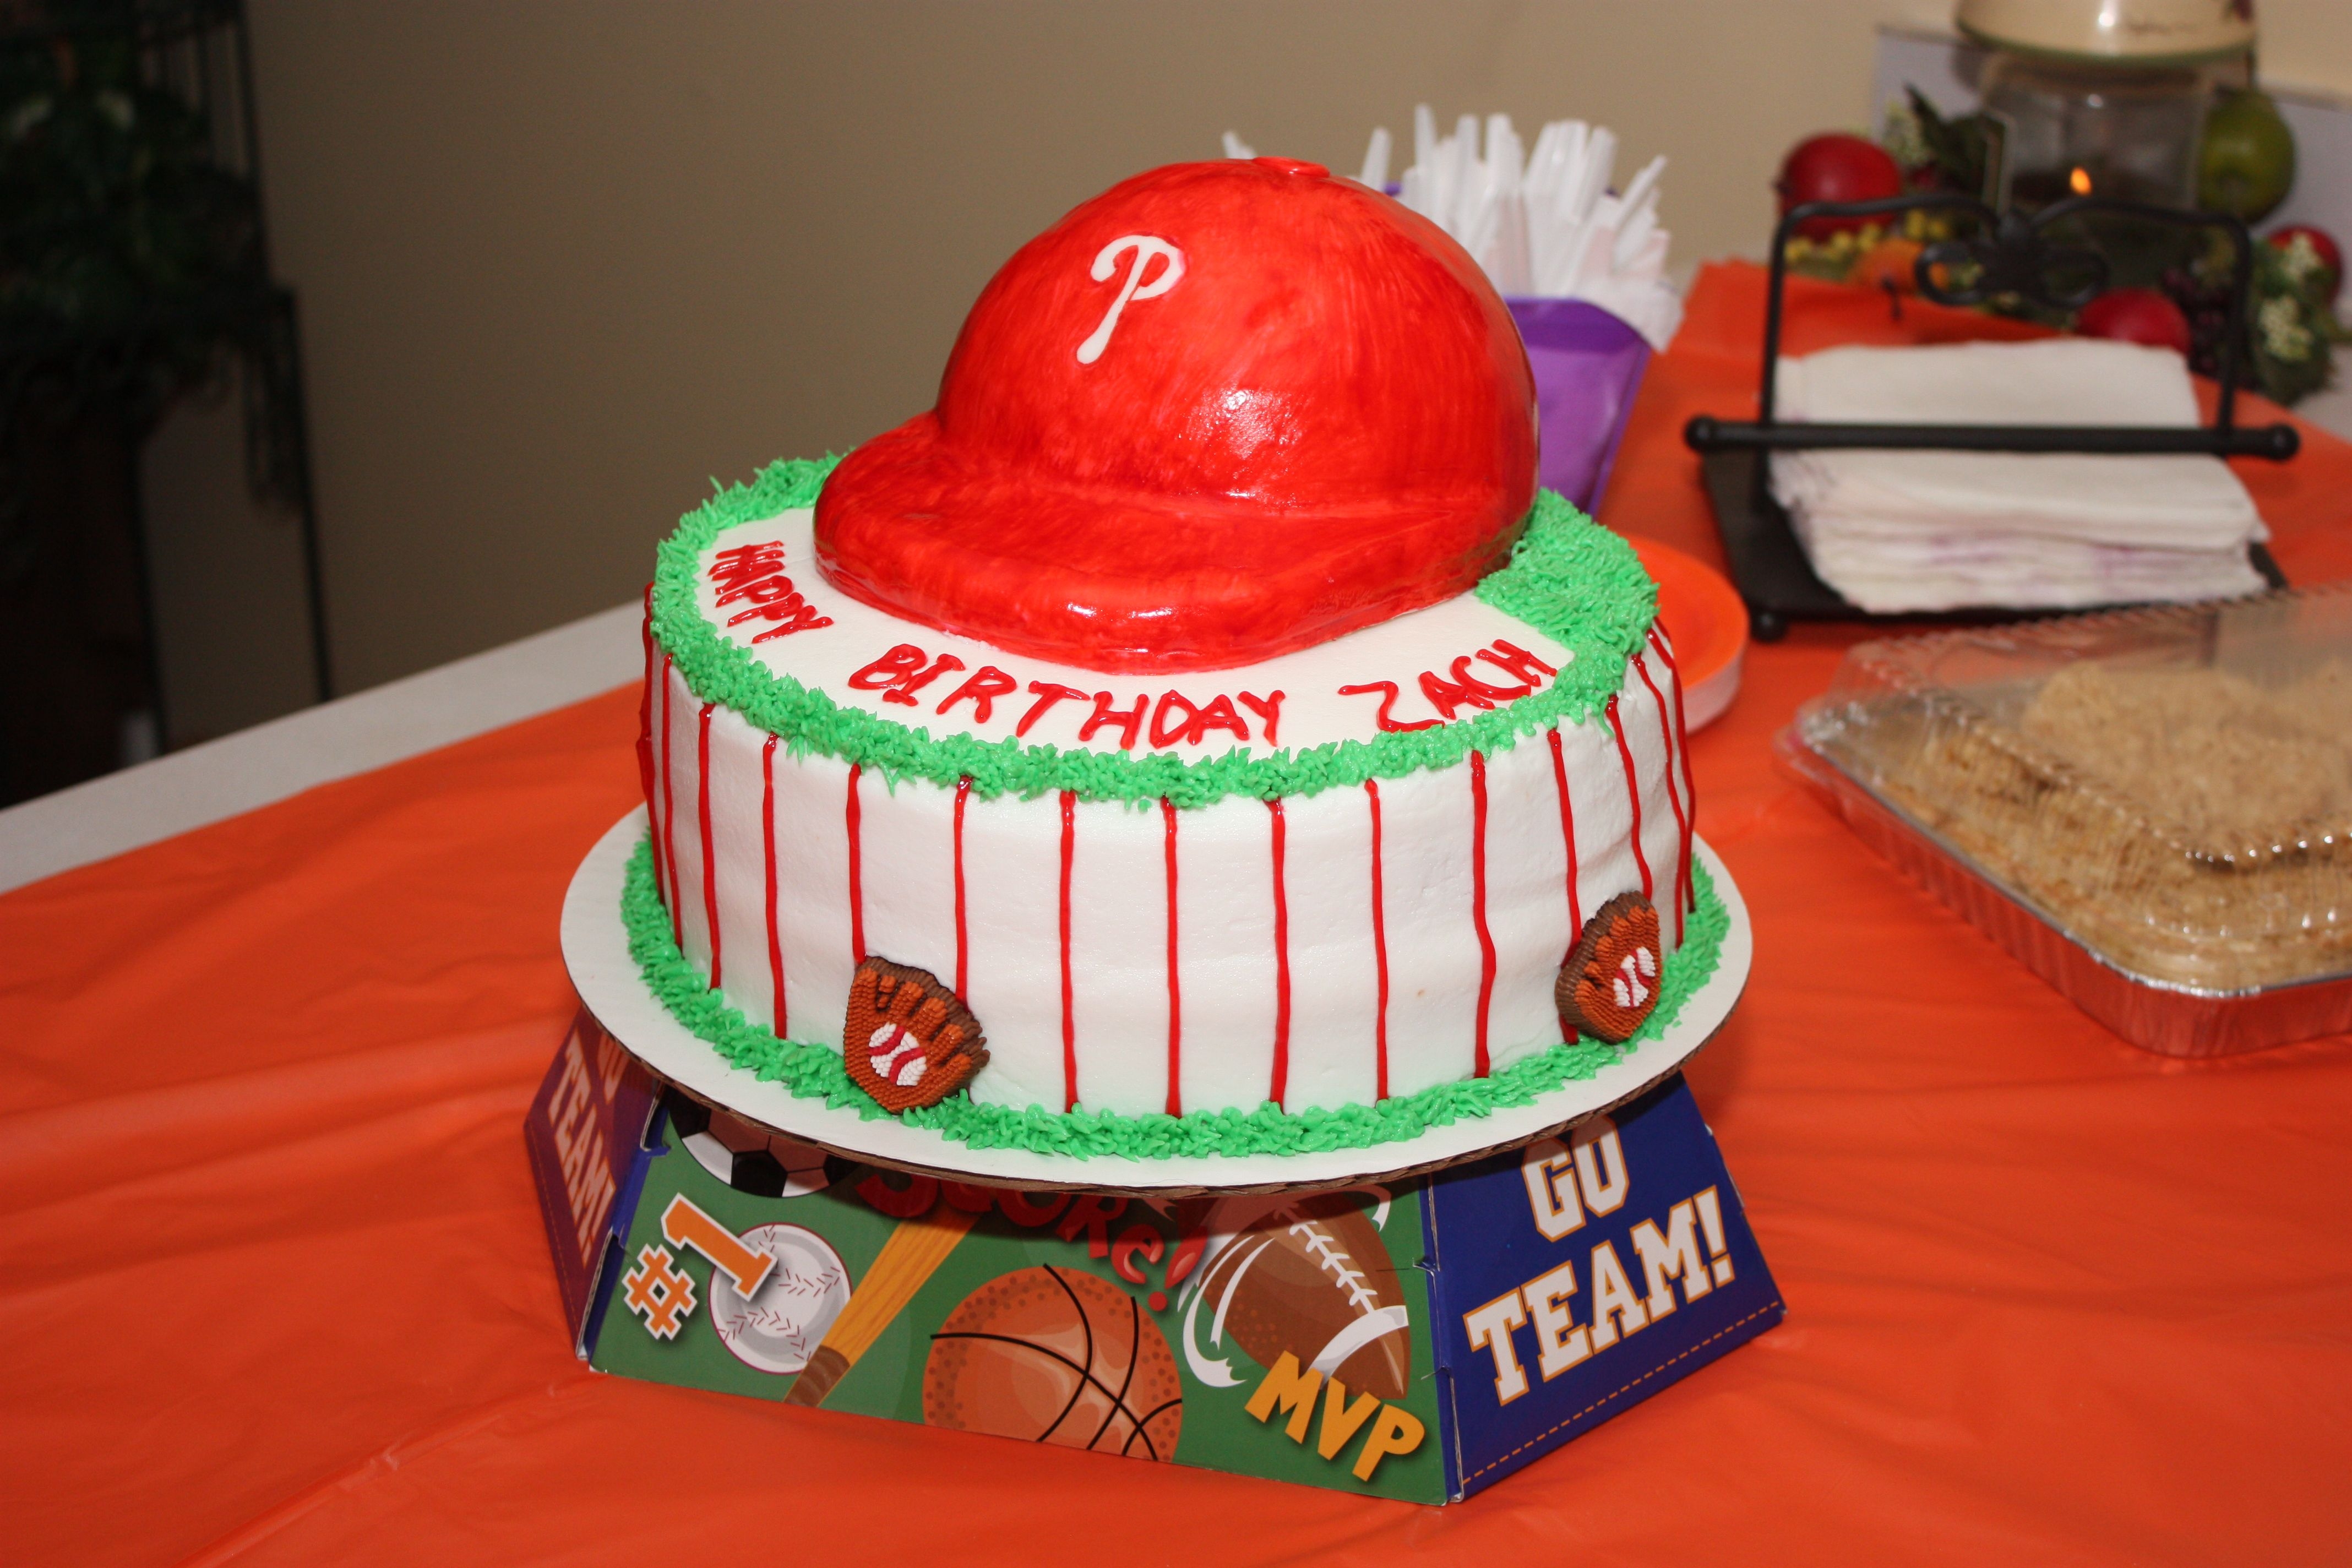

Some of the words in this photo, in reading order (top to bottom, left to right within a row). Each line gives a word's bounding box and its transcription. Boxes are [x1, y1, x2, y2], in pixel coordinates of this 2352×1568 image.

[1076, 235, 1185, 364] P
[707, 541, 834, 644] HAPPY
[848, 643, 1286, 750] BIRTHDAY
[1338, 639, 1558, 733] ZACH
[548, 1026, 617, 1269] TEAM!
[1521, 1114, 1630, 1243] GO
[622, 1192, 778, 1341] #1
[1463, 1184, 1734, 1406] TEAM!
[1244, 1350, 1425, 1482] MVP
